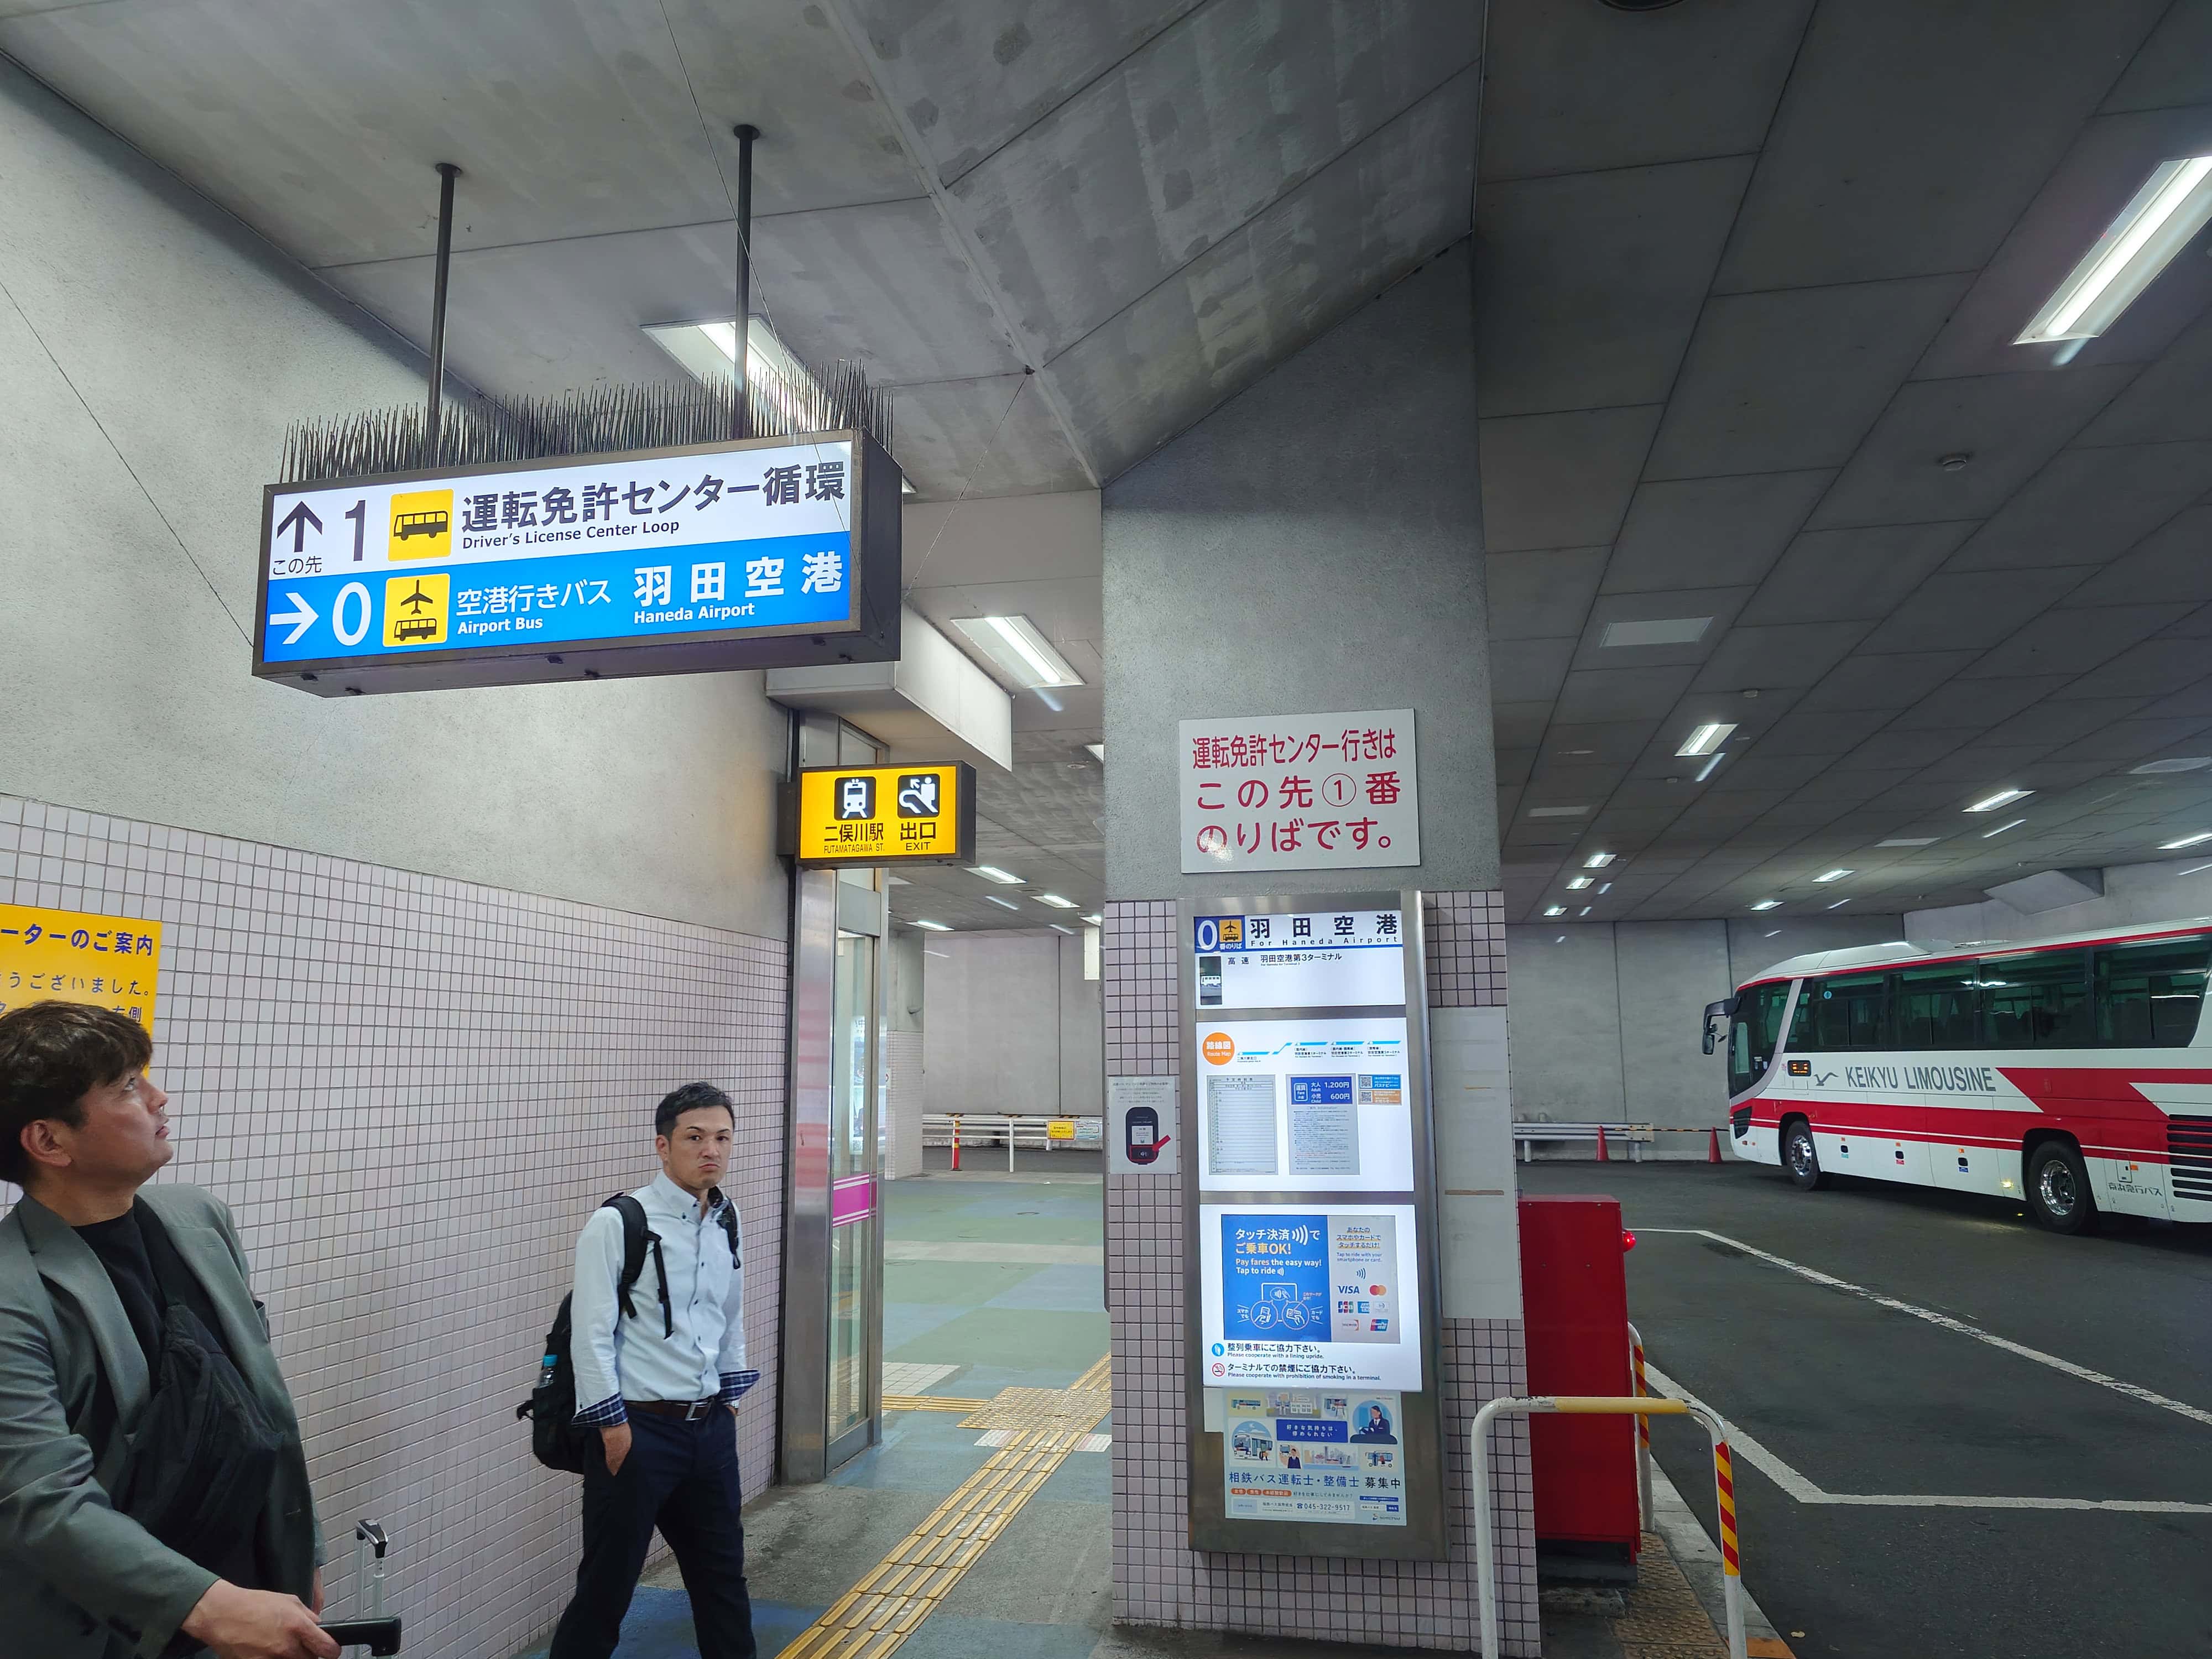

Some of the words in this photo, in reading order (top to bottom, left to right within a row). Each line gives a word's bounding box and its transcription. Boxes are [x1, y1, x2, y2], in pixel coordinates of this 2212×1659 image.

[462, 461, 845, 533] 運転免許センター循環
[345, 500, 366, 561] 1
[463, 534, 520, 549] Driver's
[525, 529, 581, 544] License
[587, 523, 637, 538] Center
[643, 521, 680, 534] Loop
[273, 556, 322, 575] この先
[633, 551, 843, 607] 羽田空港
[456, 578, 612, 616] 空港行きバス
[332, 582, 372, 646] 0
[633, 607, 693, 624] Haneda
[698, 603, 755, 620] Airport
[457, 618, 511, 636] Airport
[515, 617, 544, 629] Bus
[1192, 728, 1397, 769] 運転免許センター行きは
[824, 822, 884, 843] 二俣川駅
[900, 821, 936, 841] 出口
[1196, 817, 1392, 854] のりばです。
[823, 843, 873, 854] FUTAMATAGAWA
[875, 842, 885, 851] ST.
[905, 842, 931, 851] EXIT
[1197, 920, 1218, 951] 0
[1250, 914, 1397, 939] 羽田空港
[1, 923, 153, 956] ーターのご案内
[1260, 953, 1342, 963] 羽田空港第3ターミナル
[0, 972, 149, 996] うございました。
[1845, 1066, 1898, 1089] KEIKYU
[1904, 1066, 1996, 1092] LIMOUSINE
[1235, 1228, 1290, 1241] タッチ決済
[1235, 1258, 1249, 1266] Pay
[1285, 1260, 1302, 1268] easy
[1304, 1259, 1322, 1267] way!
[1337, 1285, 1360, 1294] VISA
[1227, 1343, 1321, 1353] 整列乗車にご協力下さい。
[1227, 1363, 1356, 1374] ターミナルでの禁煙にご協力下さい。
[1229, 1472, 1360, 1488] 相鉄バス運転士・整備士
[1364, 1477, 1401, 1489] 募集中
